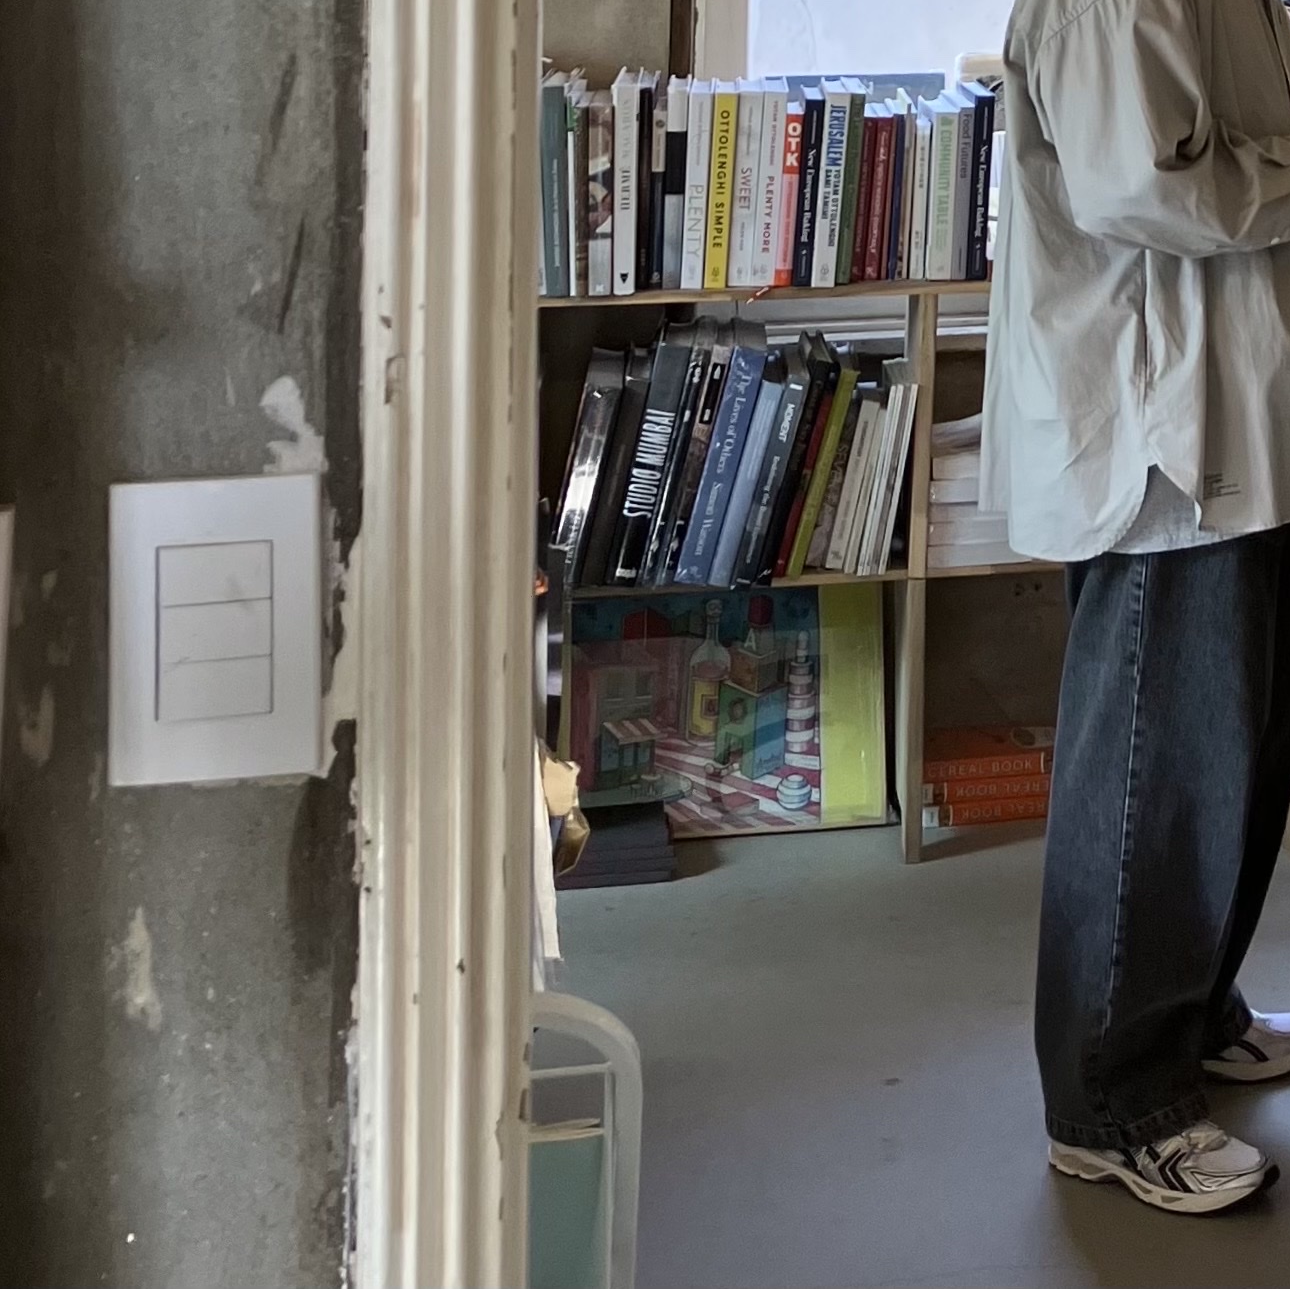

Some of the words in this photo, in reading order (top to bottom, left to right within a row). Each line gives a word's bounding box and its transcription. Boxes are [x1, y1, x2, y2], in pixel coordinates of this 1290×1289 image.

[785, 122, 802, 168] OTK
[825, 104, 847, 167] JERUSALEM
[961, 113, 973, 140] Food
[715, 109, 730, 196] OTTOLENGHI
[938, 128, 953, 192] COMMUNITY
[959, 140, 971, 180] Futures
[738, 167, 753, 211] SWEET
[765, 175, 775, 218] PLENTY
[687, 184, 704, 258] PLENTY
[712, 201, 725, 249] SIMPLE
[761, 221, 772, 254] MORE
[635, 408, 677, 467] MUMBAI
[622, 468, 662, 519] STUDIO
[991, 760, 1033, 773] BOOK
[956, 784, 997, 798] BOOK
[961, 807, 1002, 820] BOOK
[1010, 801, 1046, 815] REAL
